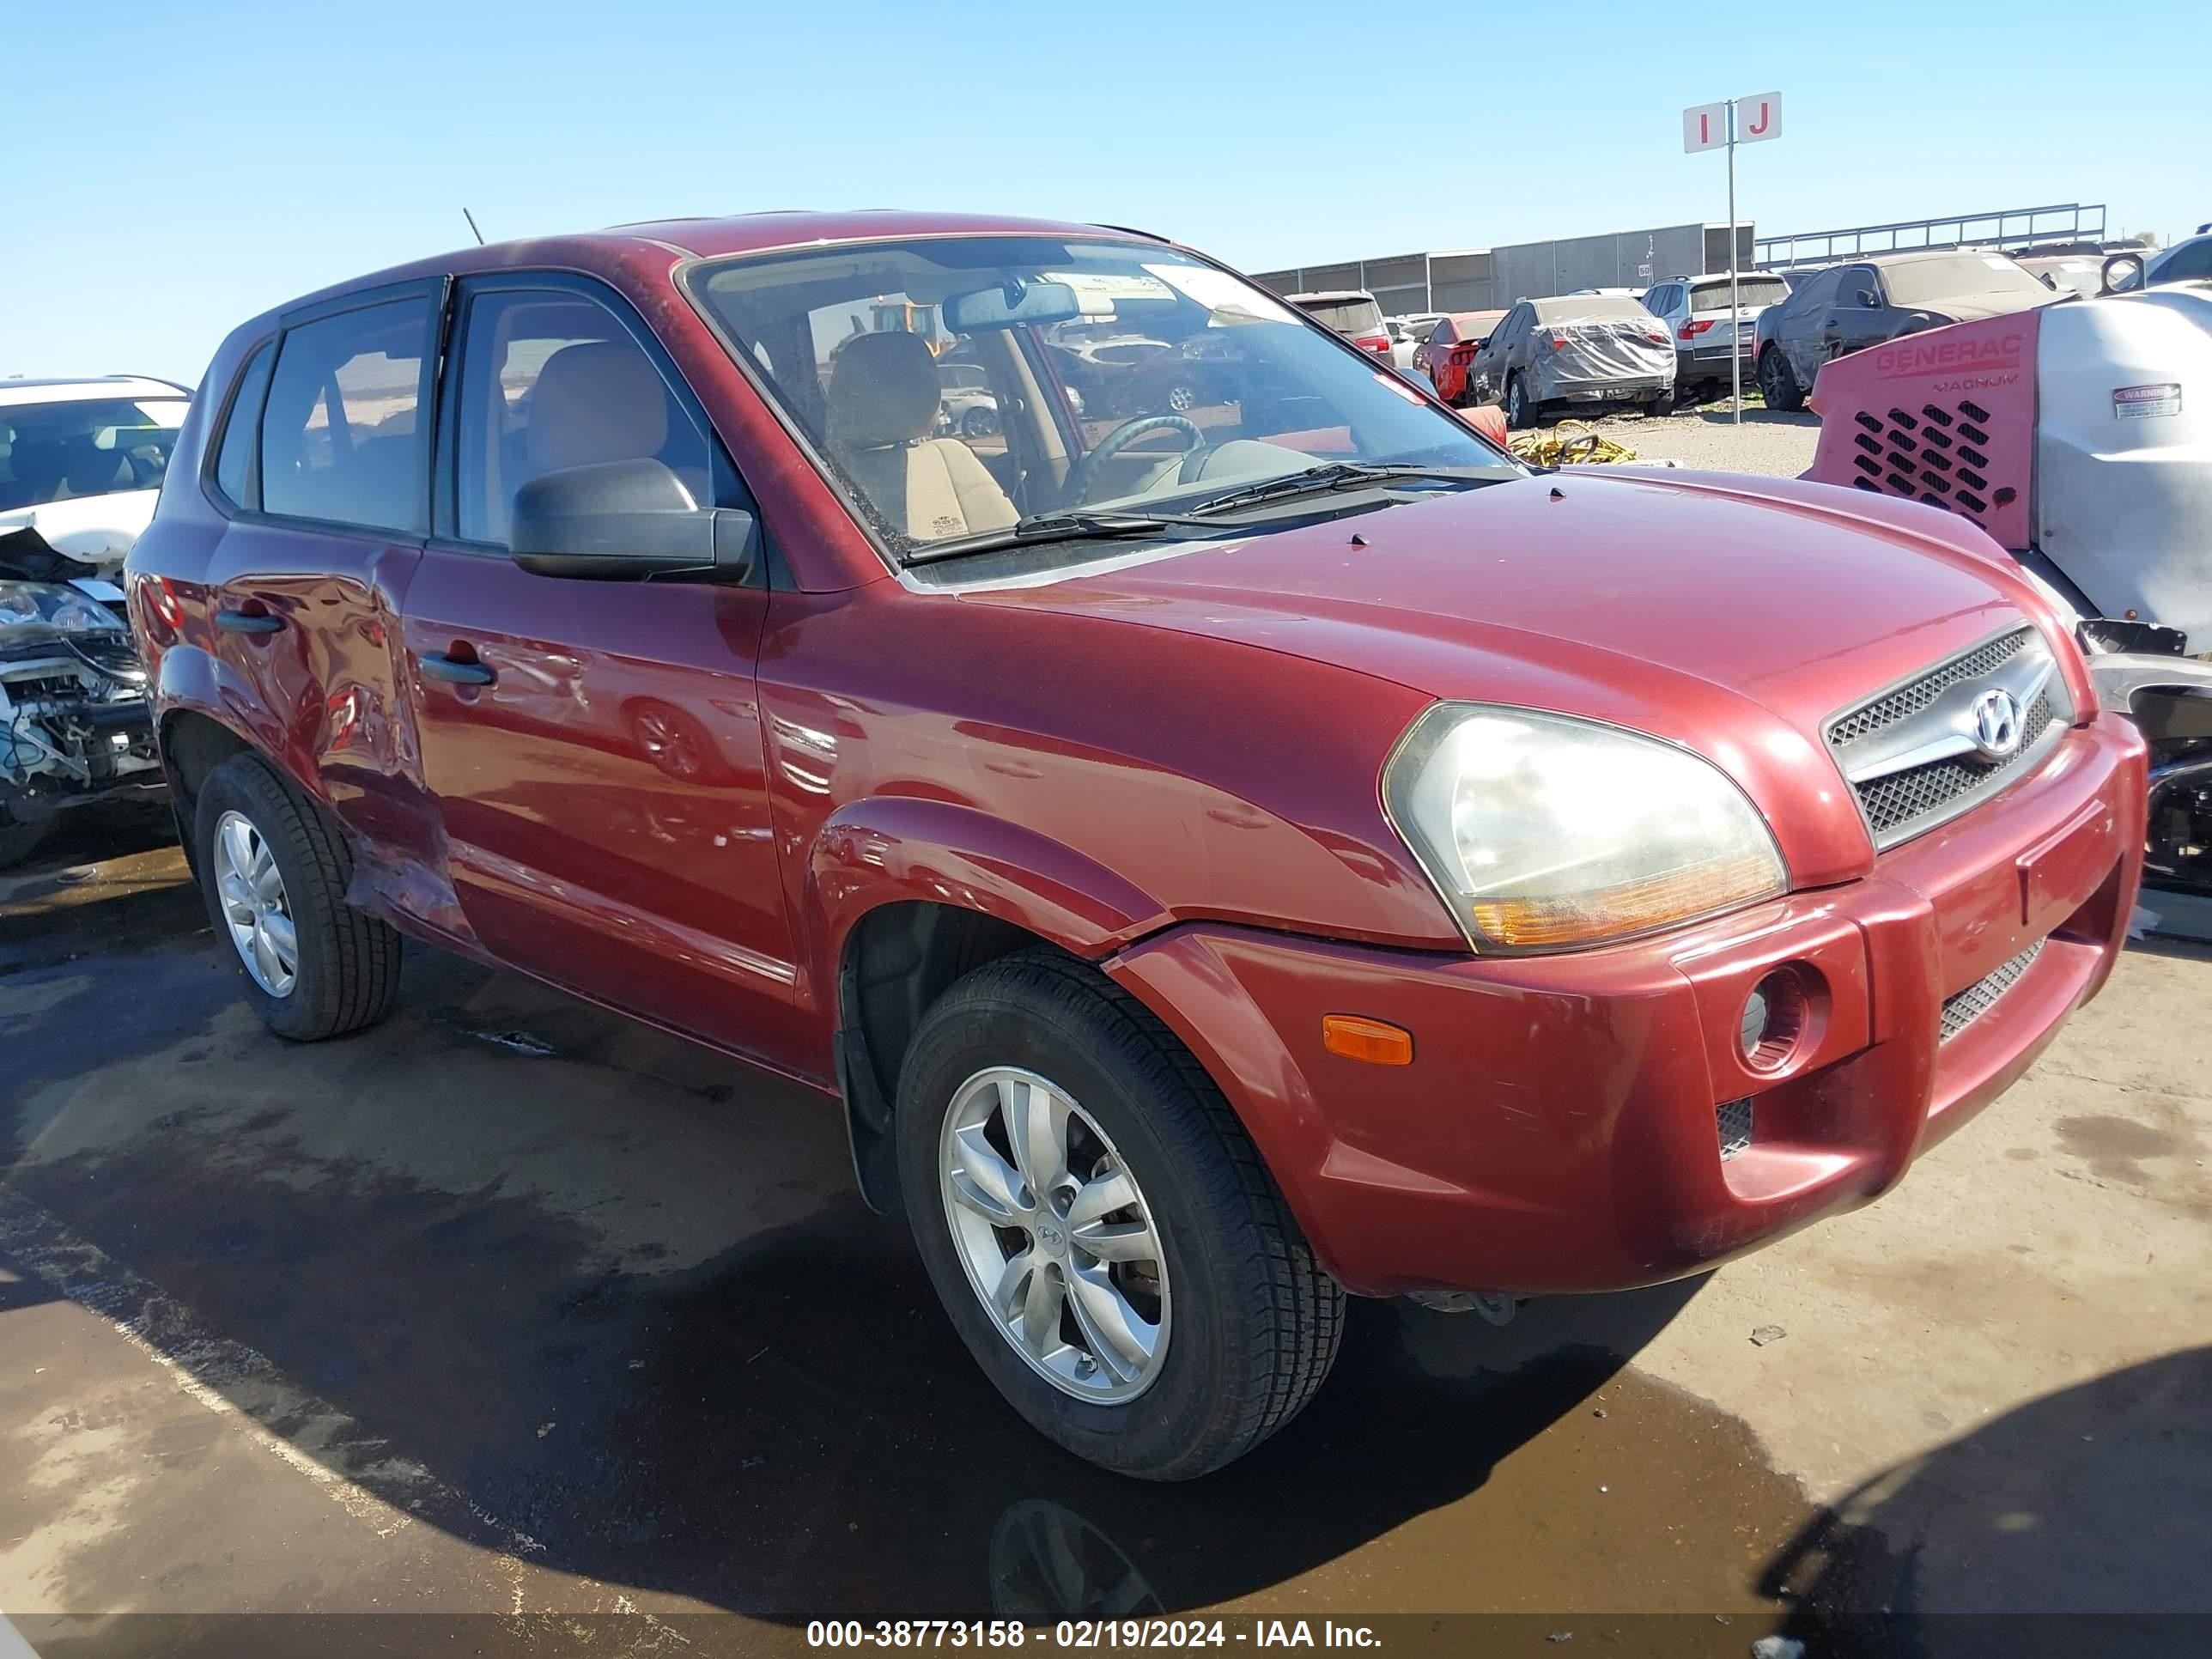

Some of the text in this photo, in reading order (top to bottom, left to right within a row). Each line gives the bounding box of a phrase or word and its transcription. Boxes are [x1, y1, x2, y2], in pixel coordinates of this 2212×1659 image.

[1701, 113, 1708, 143] I
[1749, 102, 1768, 134] J
[1875, 334, 2022, 372] GENERAC
[1933, 374, 2020, 393] MAGNUM
[2124, 388, 2170, 400] WARNIN
